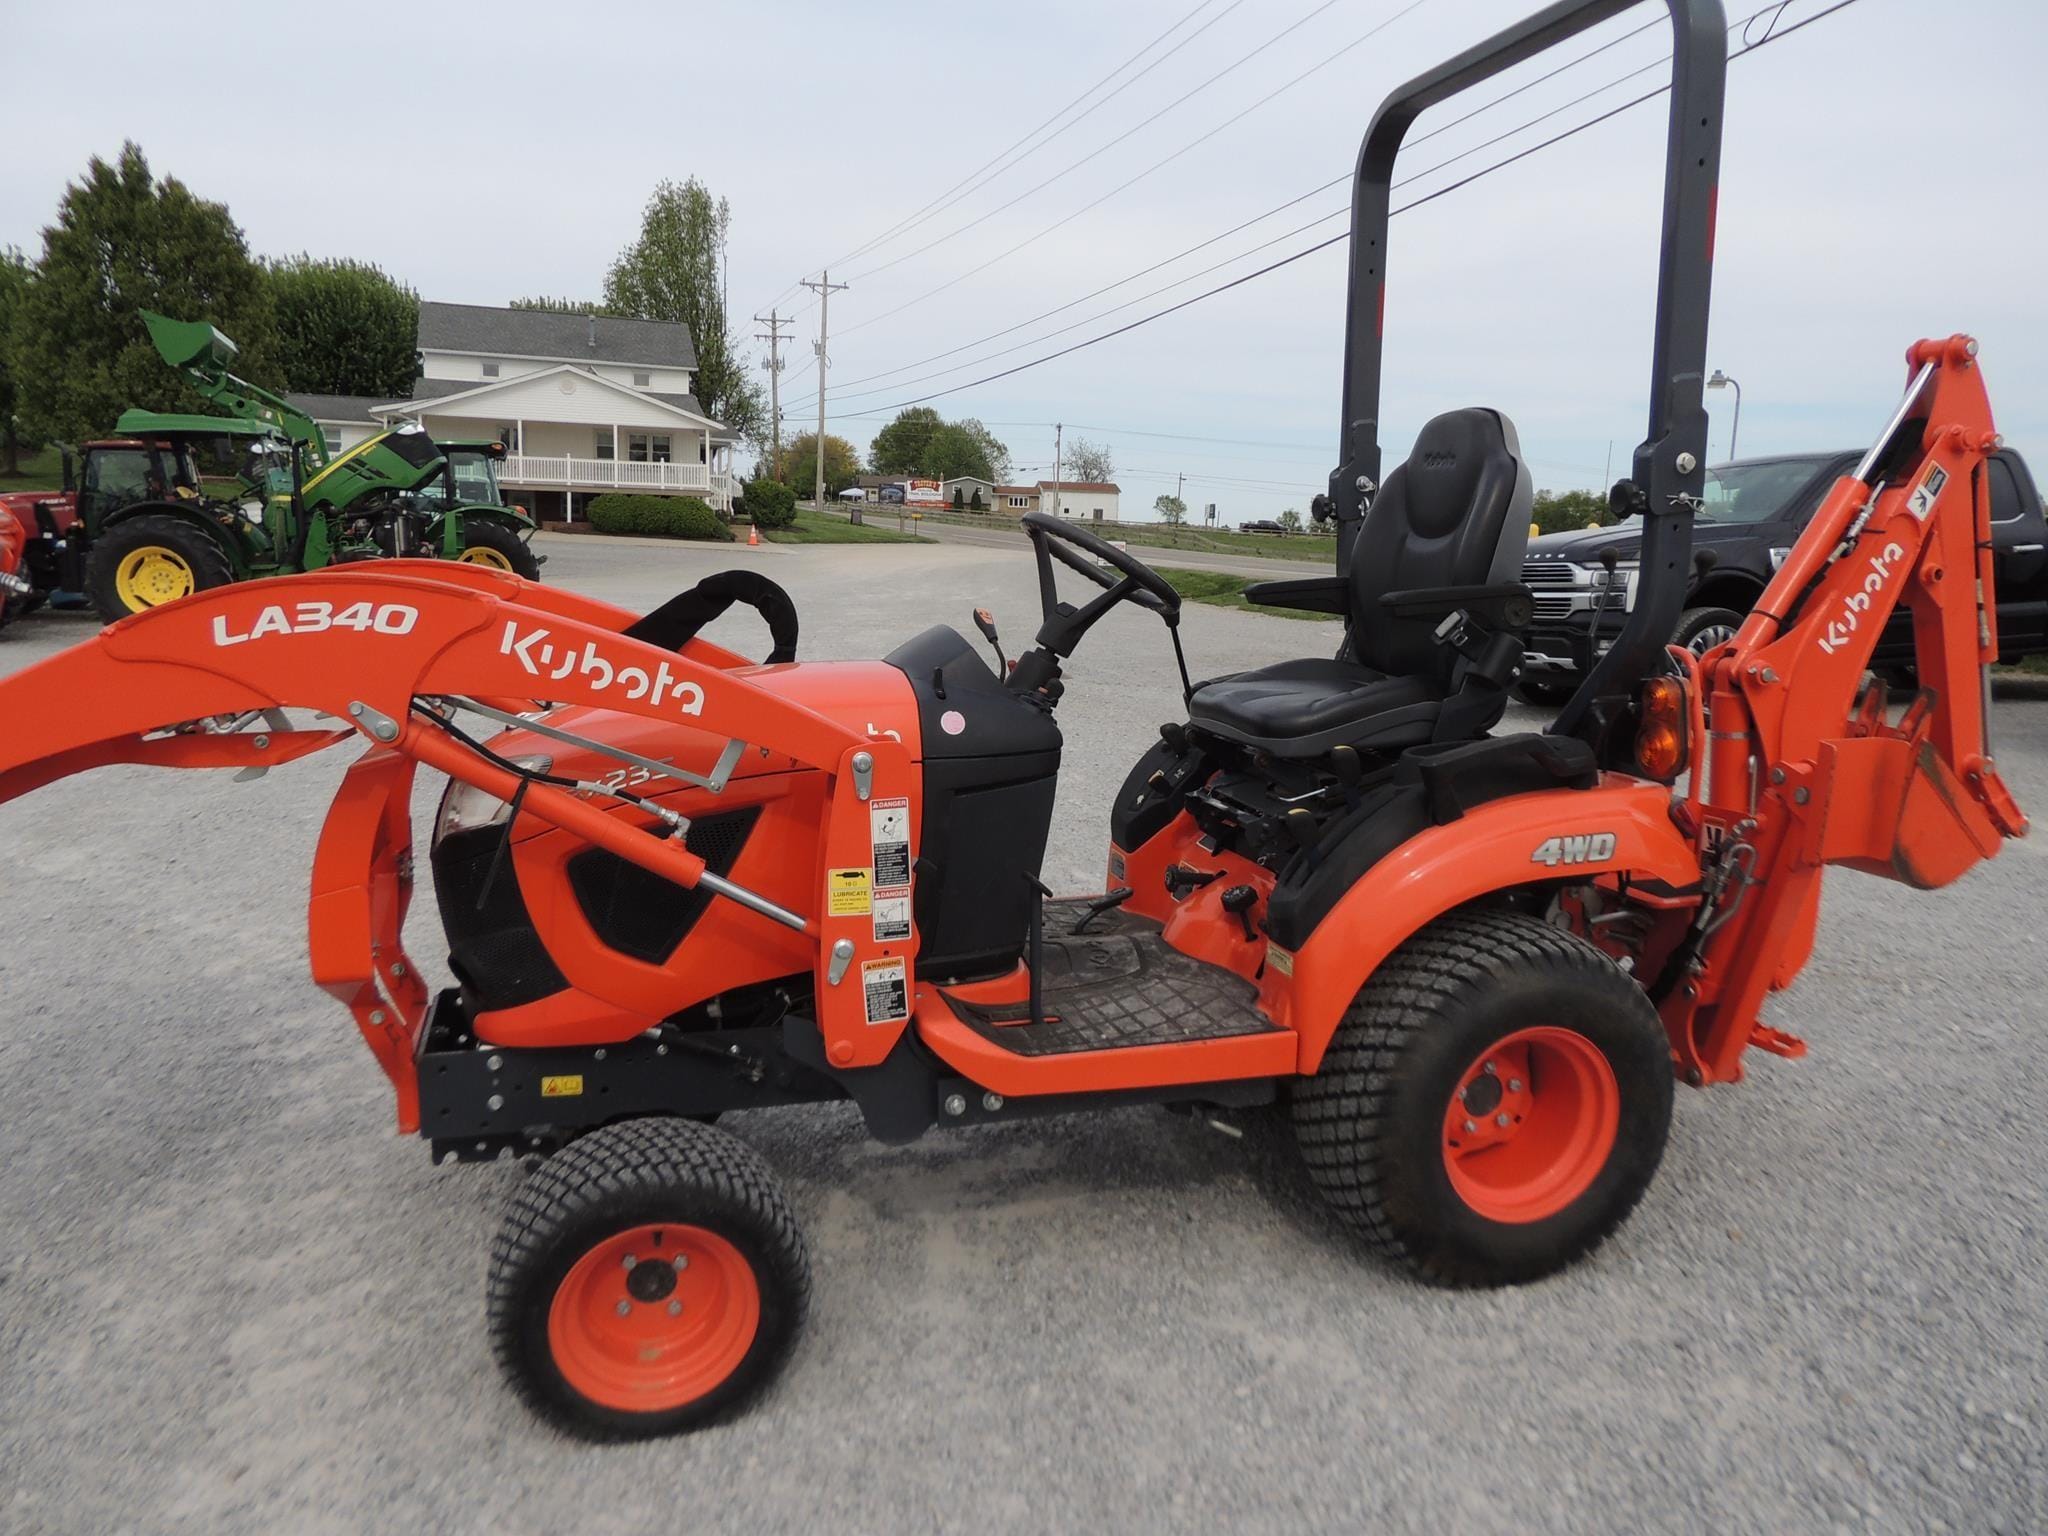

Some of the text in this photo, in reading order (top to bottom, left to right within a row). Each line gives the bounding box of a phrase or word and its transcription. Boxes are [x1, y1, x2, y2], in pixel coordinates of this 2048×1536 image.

[1818, 542, 1904, 654] Kubota
[213, 601, 419, 646] LA340
[500, 620, 704, 716] Kubota
[878, 800, 906, 808] DANGER
[1531, 831, 1616, 867] 4WD
[880, 888, 907, 898] DANGER
[872, 959, 900, 970] WARNING
